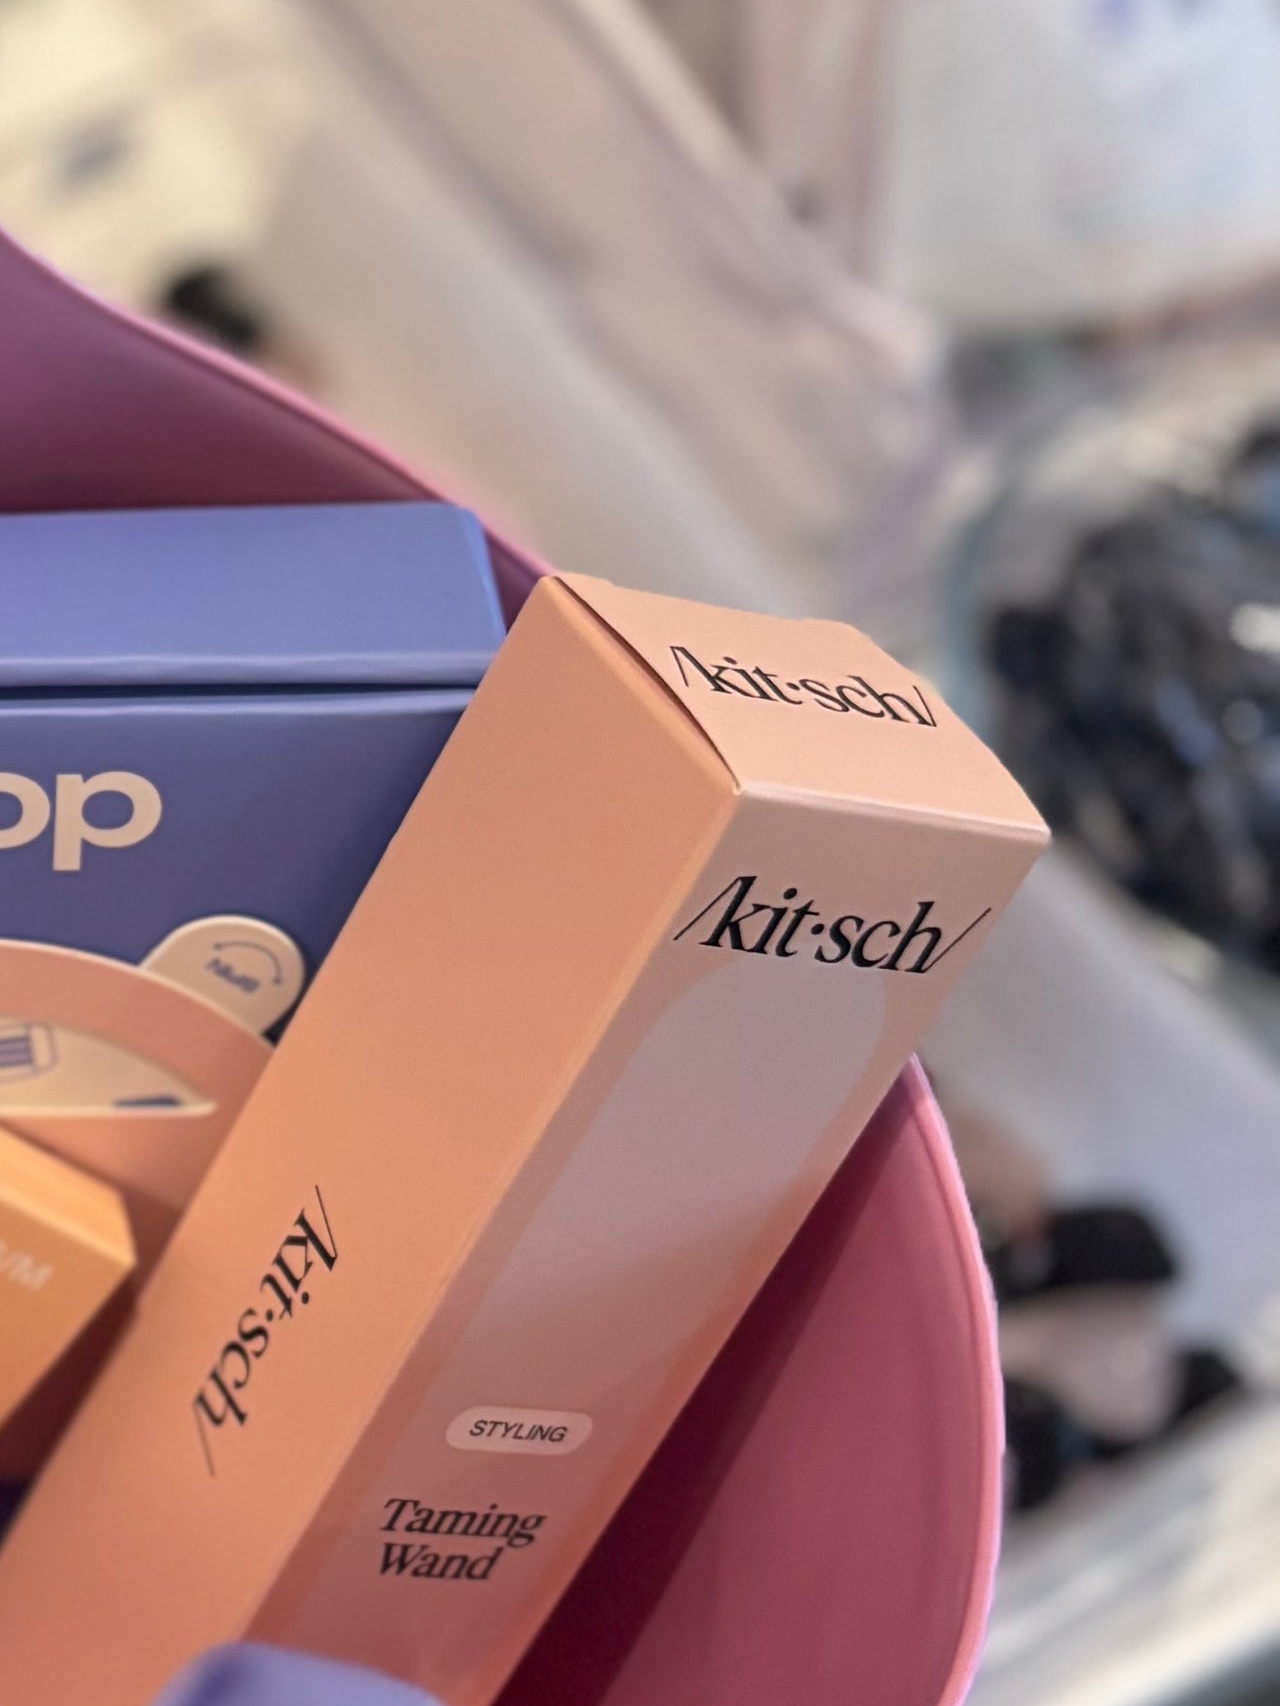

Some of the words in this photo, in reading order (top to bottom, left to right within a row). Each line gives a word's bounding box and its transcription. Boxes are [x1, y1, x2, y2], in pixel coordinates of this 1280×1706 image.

[469, 1419, 568, 1443] STYLING
[380, 1497, 548, 1549] Taming
[379, 1542, 504, 1581] Wand
